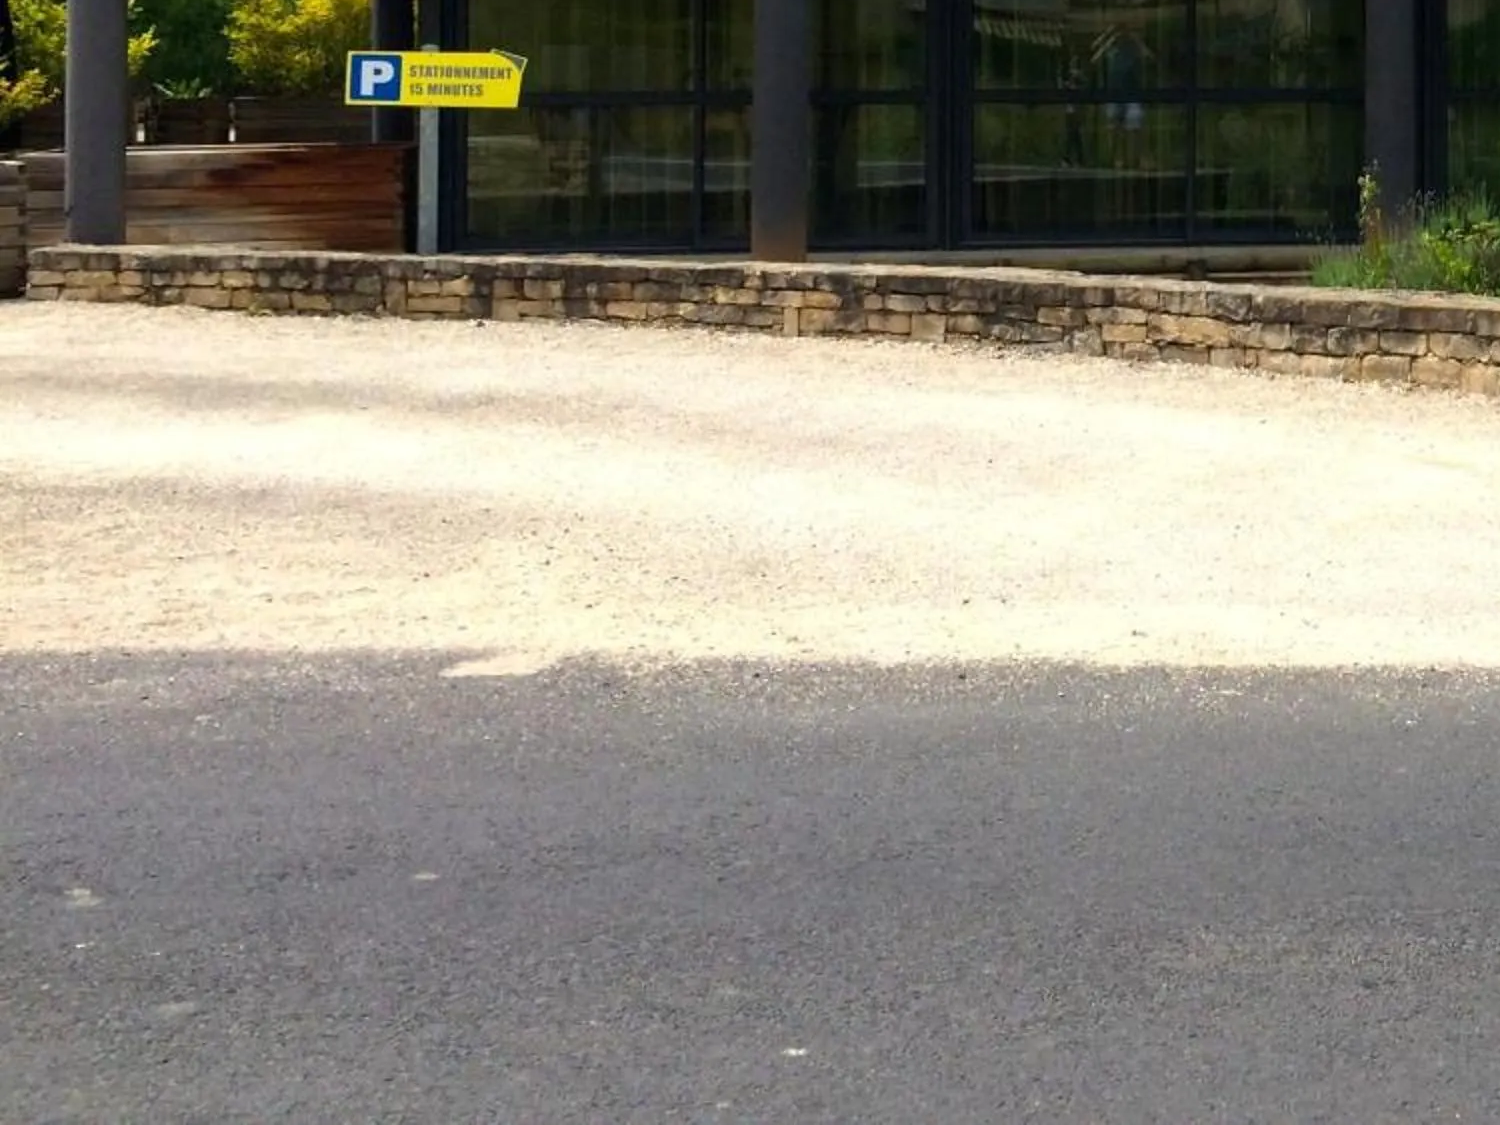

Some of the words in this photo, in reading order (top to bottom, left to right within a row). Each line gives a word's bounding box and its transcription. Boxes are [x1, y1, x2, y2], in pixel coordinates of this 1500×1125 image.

[409, 65, 513, 80] STATIONNEMENT
[410, 84, 424, 95] 15
[427, 84, 484, 96] MINUTES
